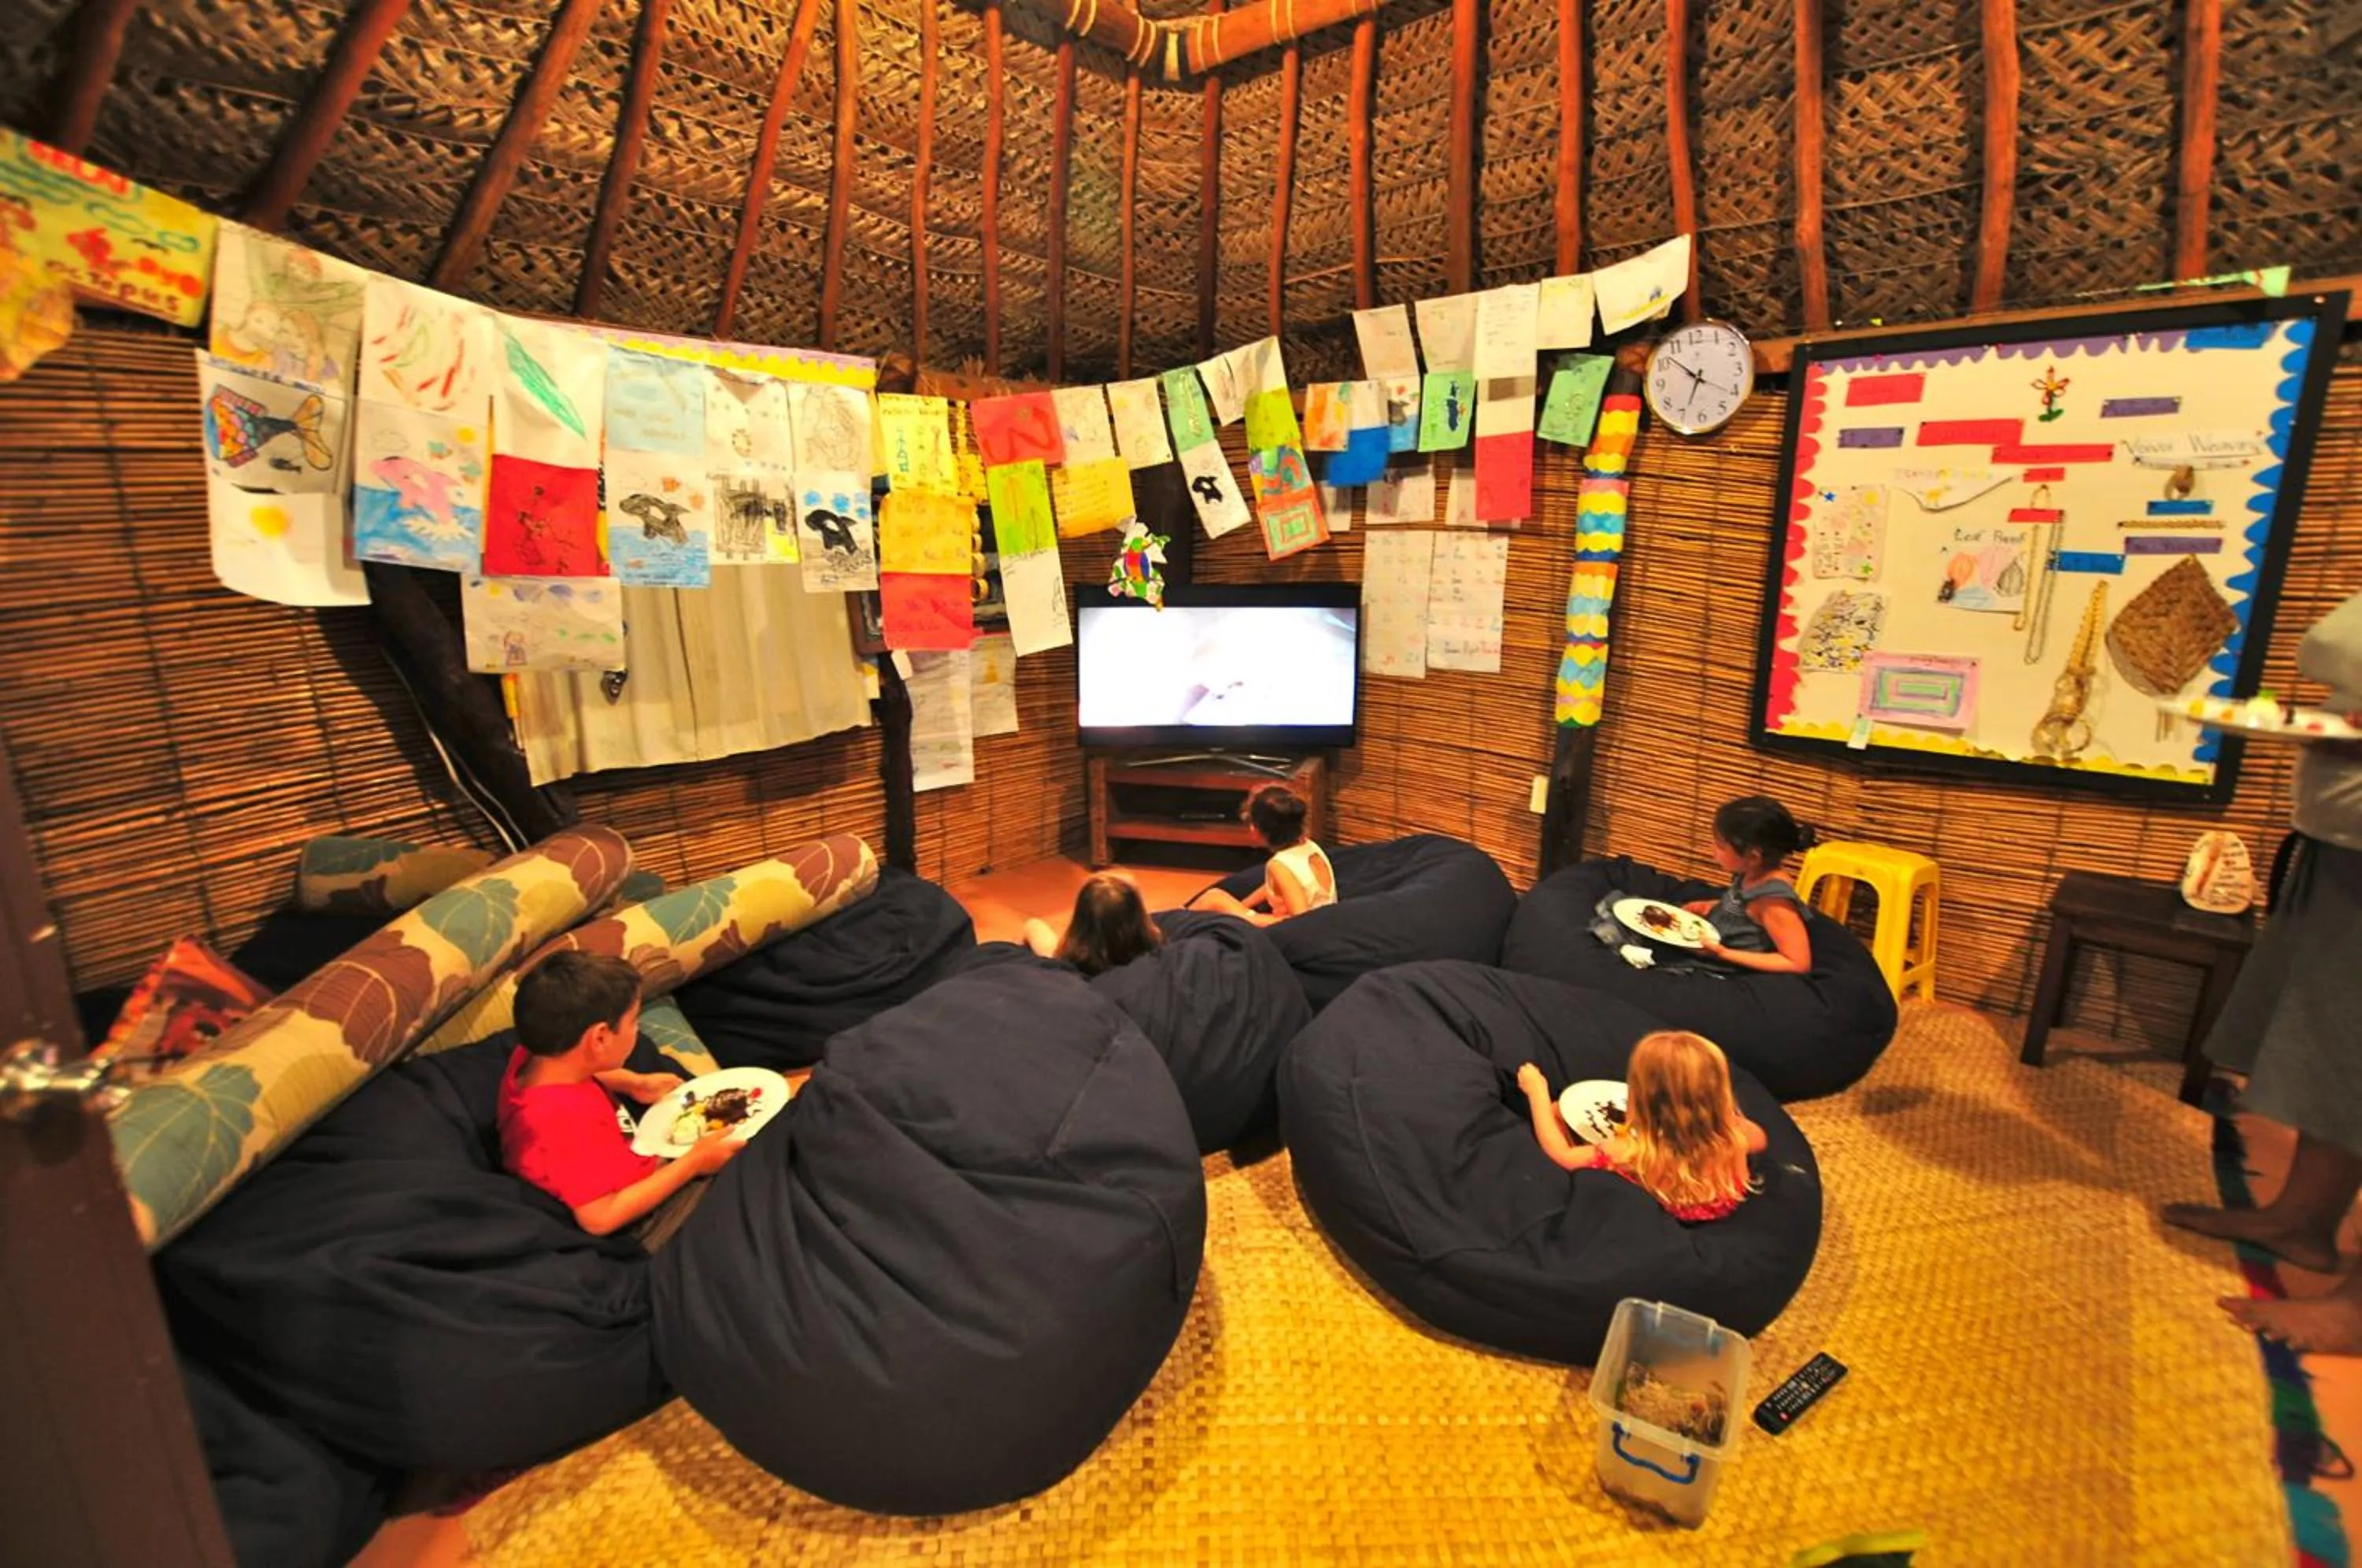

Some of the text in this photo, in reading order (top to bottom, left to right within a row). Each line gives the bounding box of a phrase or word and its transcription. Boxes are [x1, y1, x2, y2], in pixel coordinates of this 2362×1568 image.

[1688, 329, 1703, 346] 12
[1714, 331, 1720, 345] 1
[1670, 339, 1682, 354] 11
[1727, 341, 1737, 357] 2
[1657, 356, 1670, 372] 10
[1733, 361, 1743, 376] 3
[1655, 378, 1665, 393] 9
[1730, 383, 1739, 396] 4
[1662, 395, 1673, 411] 8
[1717, 400, 1727, 416] 5
[1678, 407, 1686, 423] 7
[1697, 409, 1708, 423] 6
